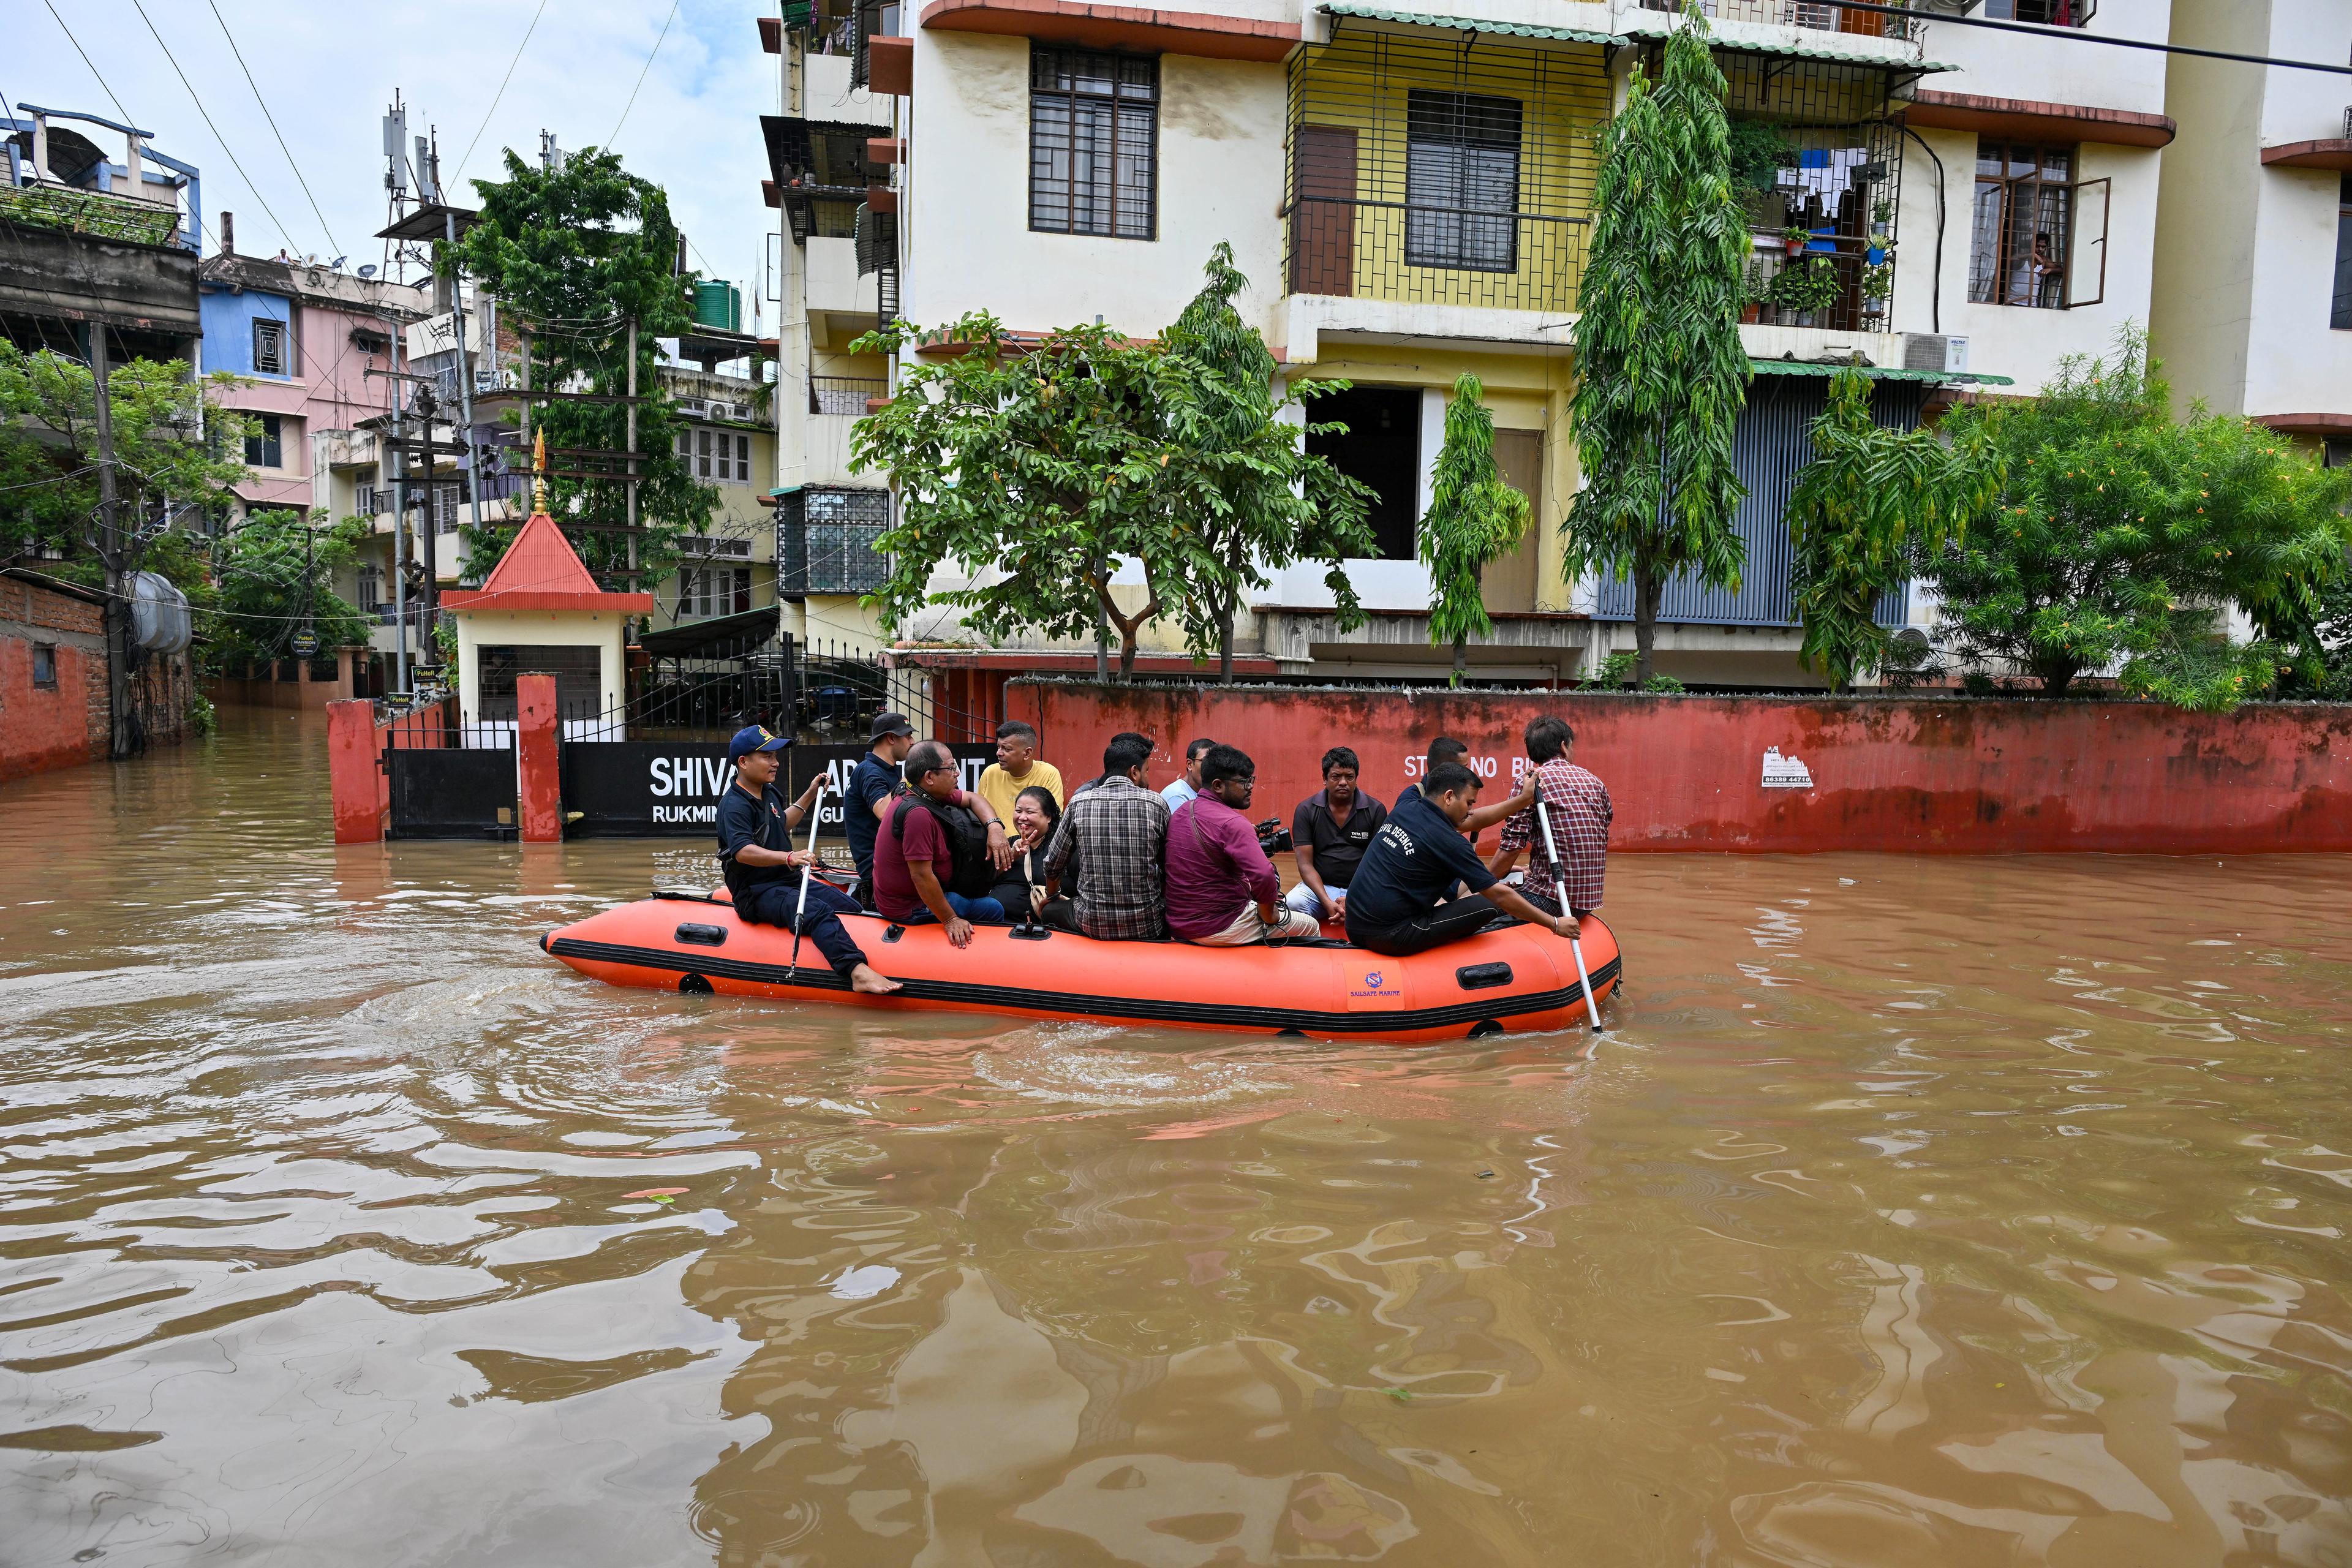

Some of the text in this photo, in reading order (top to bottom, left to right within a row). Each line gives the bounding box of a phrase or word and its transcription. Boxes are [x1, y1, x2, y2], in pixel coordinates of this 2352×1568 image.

[1471, 756, 1497, 778] NO
[1512, 756, 1534, 777] BI
[1382, 836, 1397, 849] ASSAM
[1391, 826, 1415, 856] DEFENCE
